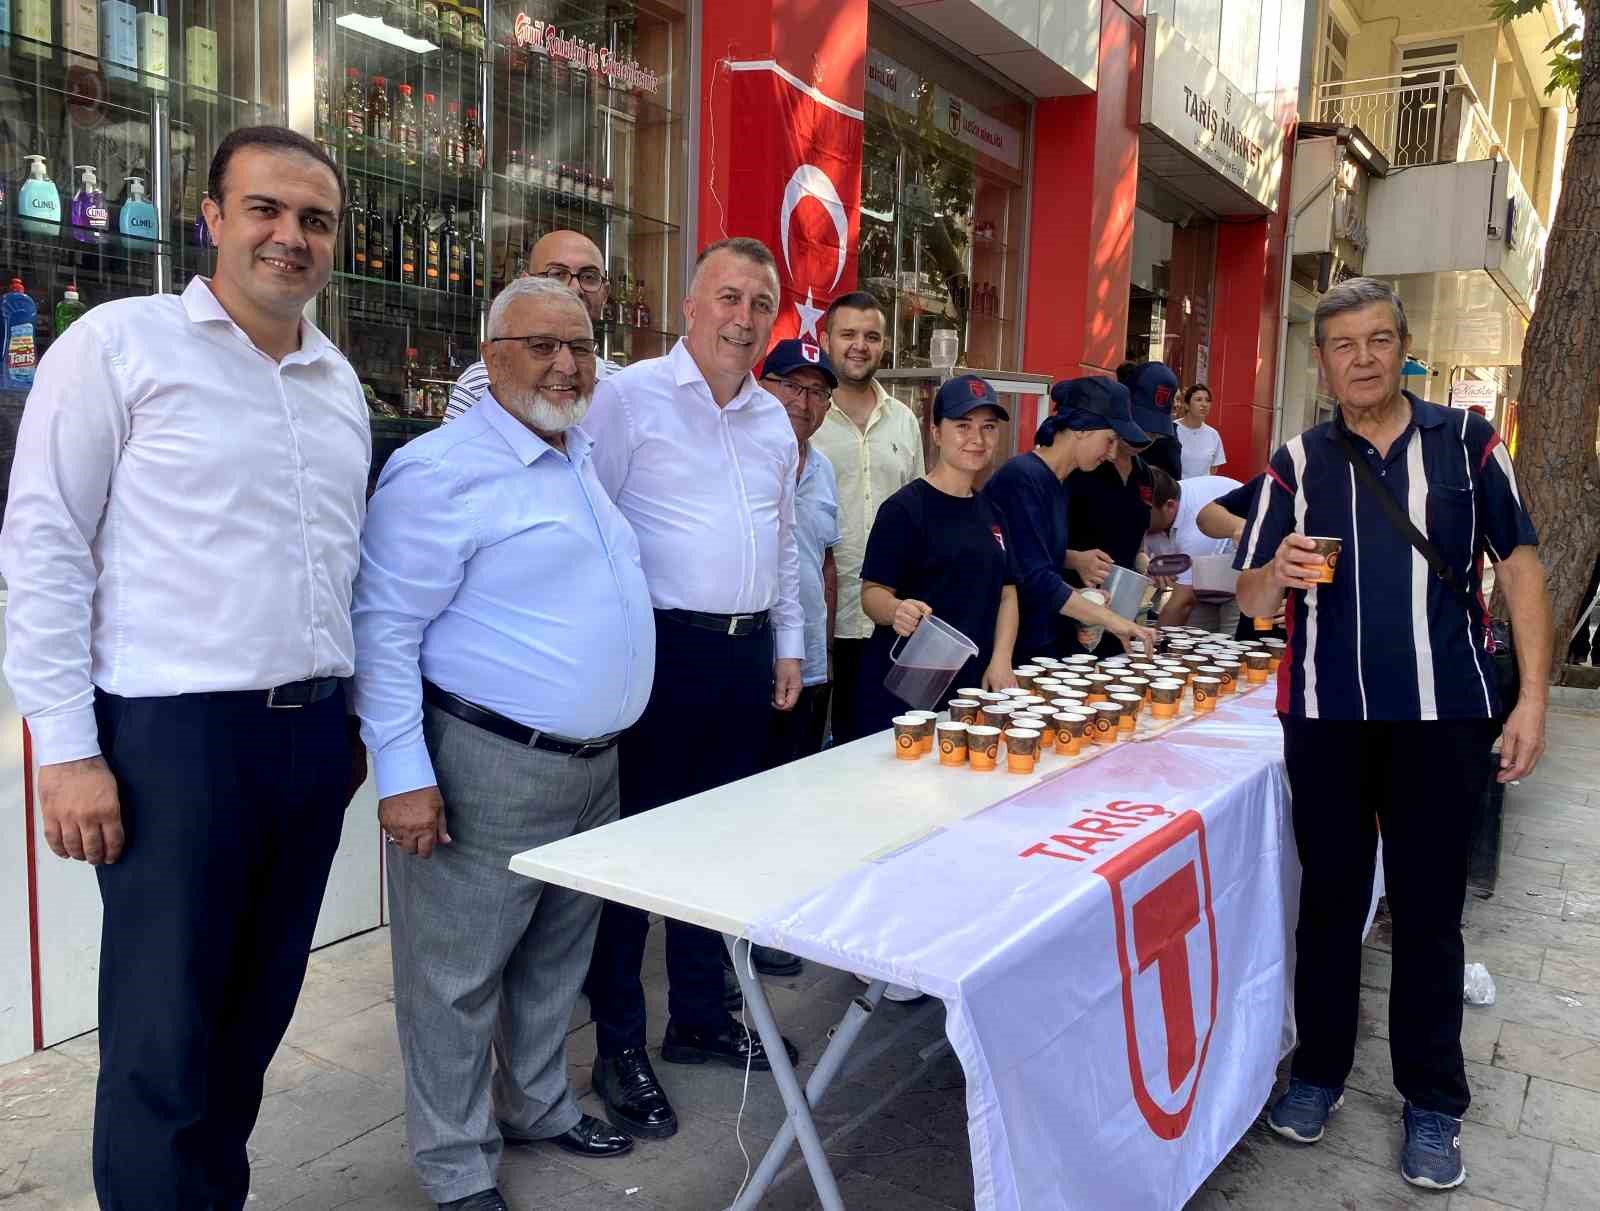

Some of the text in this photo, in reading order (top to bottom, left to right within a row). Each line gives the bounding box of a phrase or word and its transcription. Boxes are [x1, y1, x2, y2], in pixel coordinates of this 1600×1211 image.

[1184, 85, 1218, 142] TARİŞ
[1220, 117, 1263, 169] MARKET
[1018, 800, 1177, 863] TARİŞ
